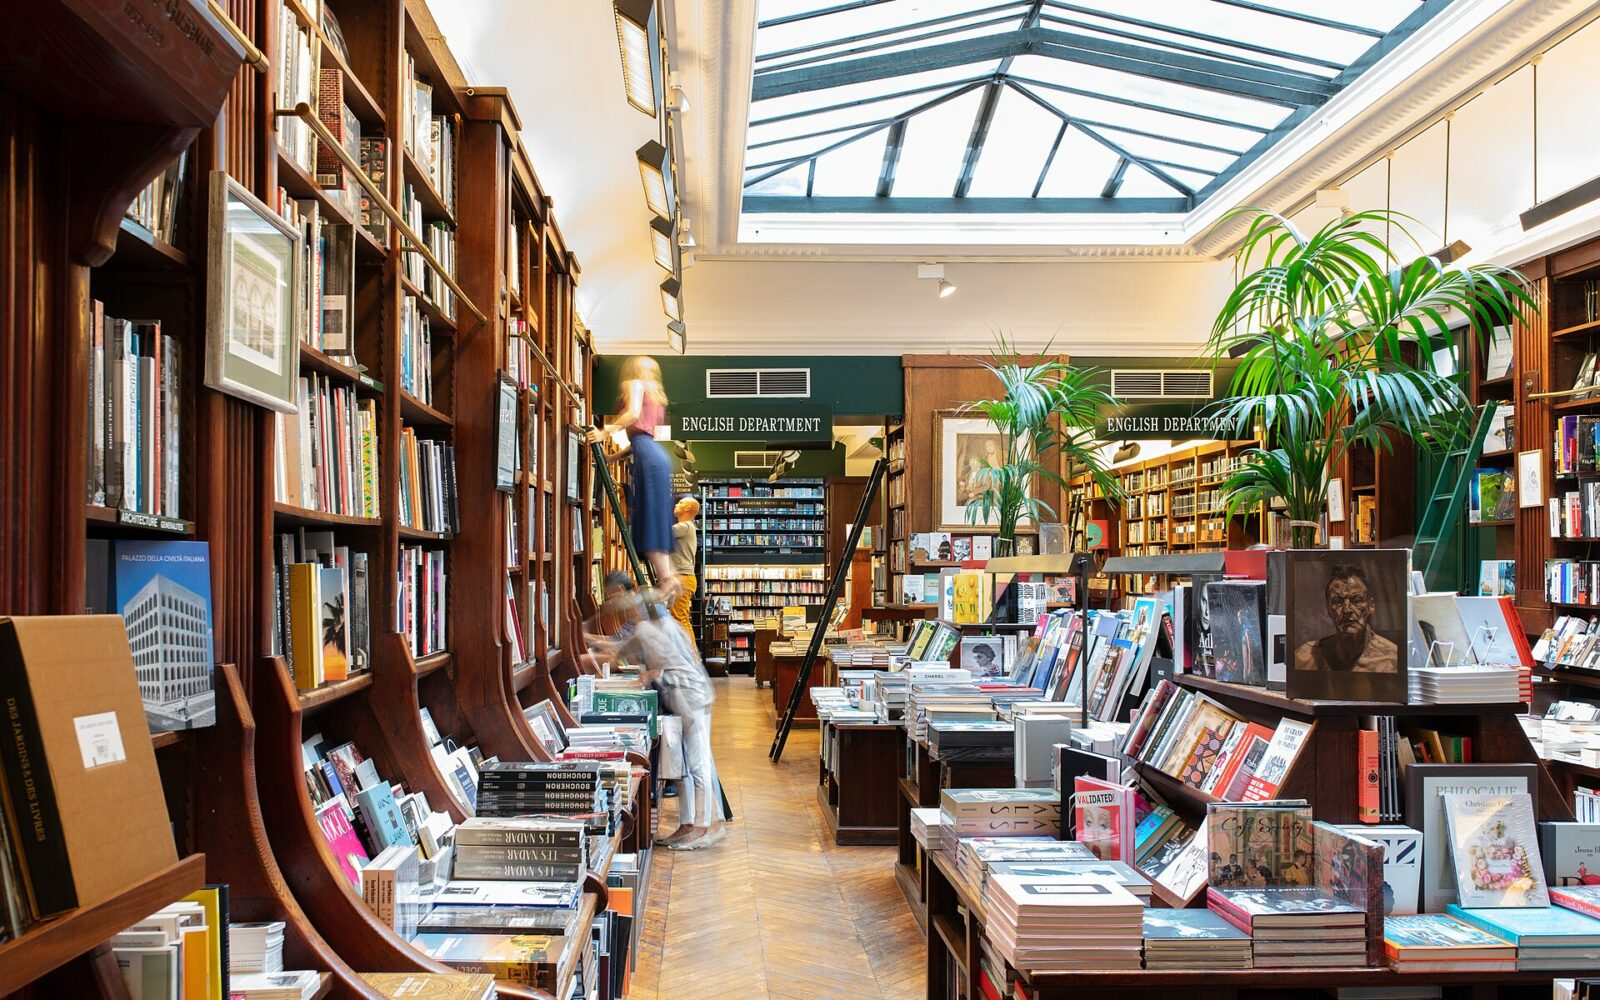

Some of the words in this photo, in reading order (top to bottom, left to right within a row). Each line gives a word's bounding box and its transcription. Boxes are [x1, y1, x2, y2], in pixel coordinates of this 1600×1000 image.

[682, 417, 734, 432] ENGLISH
[739, 417, 821, 432] DEPARTMENT
[1107, 417, 1159, 432] ENGLISH
[121, 512, 158, 528] ARCHITECTURE
[121, 554, 146, 562] PALAZZO
[183, 555, 205, 563] ITALIANA
[1025, 584, 1034, 600] SHOP
[1025, 607, 1034, 623] WORK
[7, 698, 19, 720] DES
[13, 721, 30, 769] JARDINS
[23, 770, 32, 778] &
[546, 772, 592, 780] BOUCHERON
[25, 779, 37, 801] DES
[544, 801, 590, 809] BOUCHERON
[1465, 800, 1497, 809] Christian
[30, 802, 46, 842] LIVRES
[316, 806, 354, 842] VOGUE
[505, 832, 537, 845] NADAR
[539, 833, 555, 844] LES
[507, 849, 538, 861] NADAR
[541, 849, 557, 861] LES
[1574, 845, 1594, 854] Jeune
[504, 865, 534, 877] NADAR
[538, 865, 554, 877] LES
